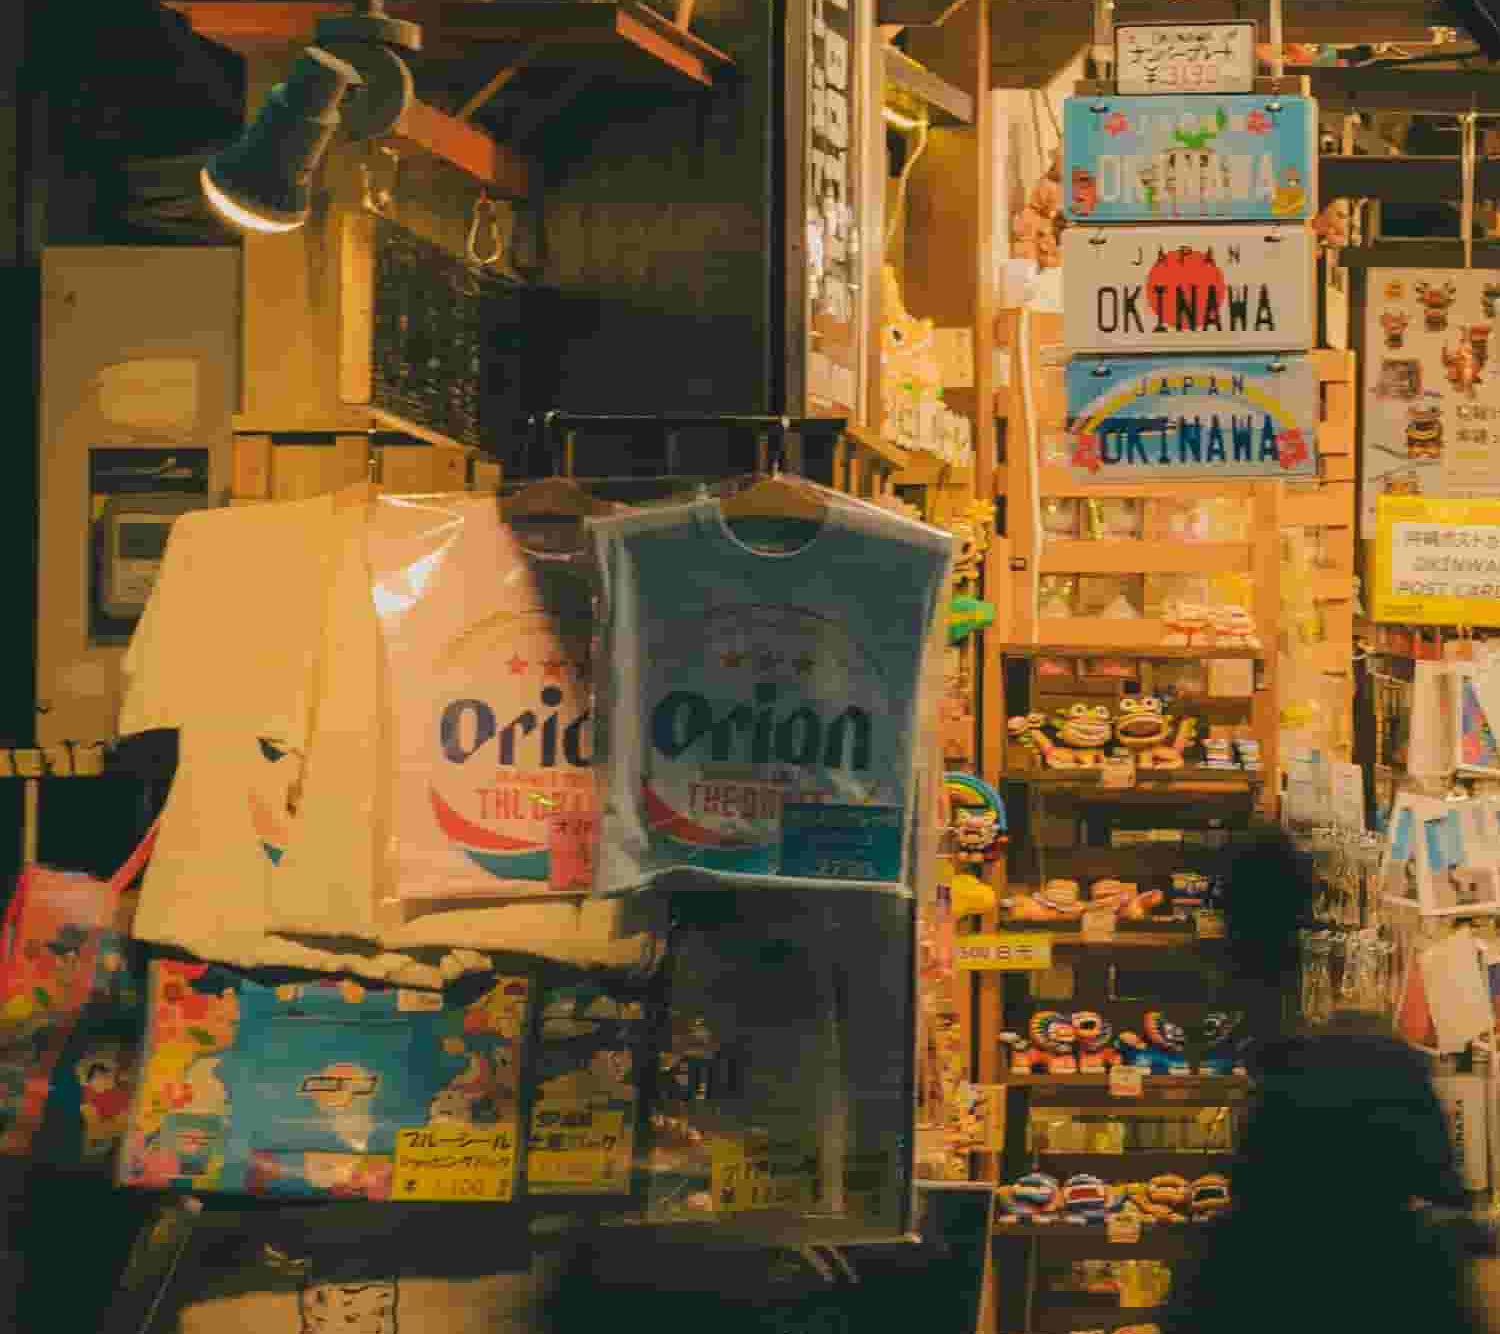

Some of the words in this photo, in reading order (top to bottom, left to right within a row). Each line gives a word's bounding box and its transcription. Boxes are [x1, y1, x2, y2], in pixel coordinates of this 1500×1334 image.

[1131, 244, 1241, 267] JAPAN
[1096, 284, 1276, 333] OKINAWA
[1134, 374, 1245, 397] JAPAN
[1100, 414, 1281, 465] OKINAWA
[438, 685, 602, 767] Orio
[650, 682, 874, 770] Orion
